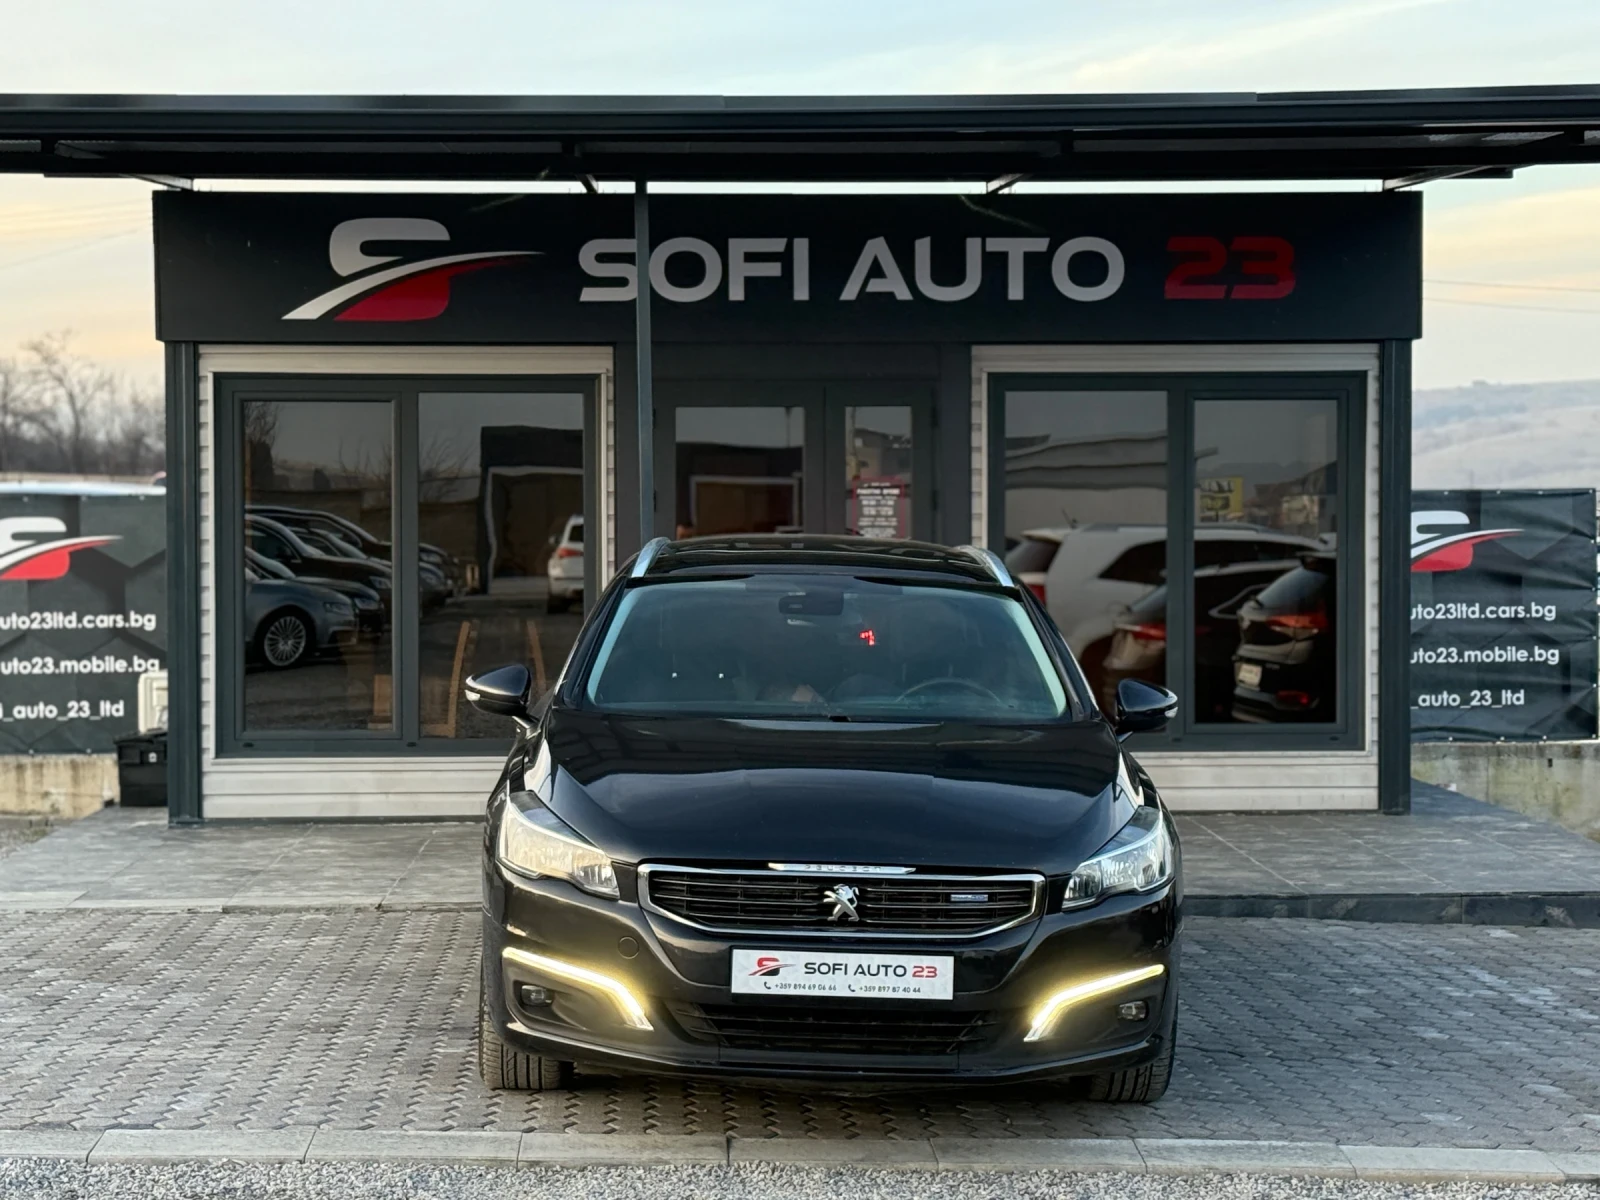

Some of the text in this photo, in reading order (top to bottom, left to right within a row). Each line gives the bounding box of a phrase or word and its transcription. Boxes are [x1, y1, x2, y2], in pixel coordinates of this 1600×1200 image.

[579, 236, 1297, 302] SOFI AUTO 23
[804, 962, 938, 978] SOFI AUTO 23
[775, 982, 792, 990] +359
[878, 985, 890, 993] 897
